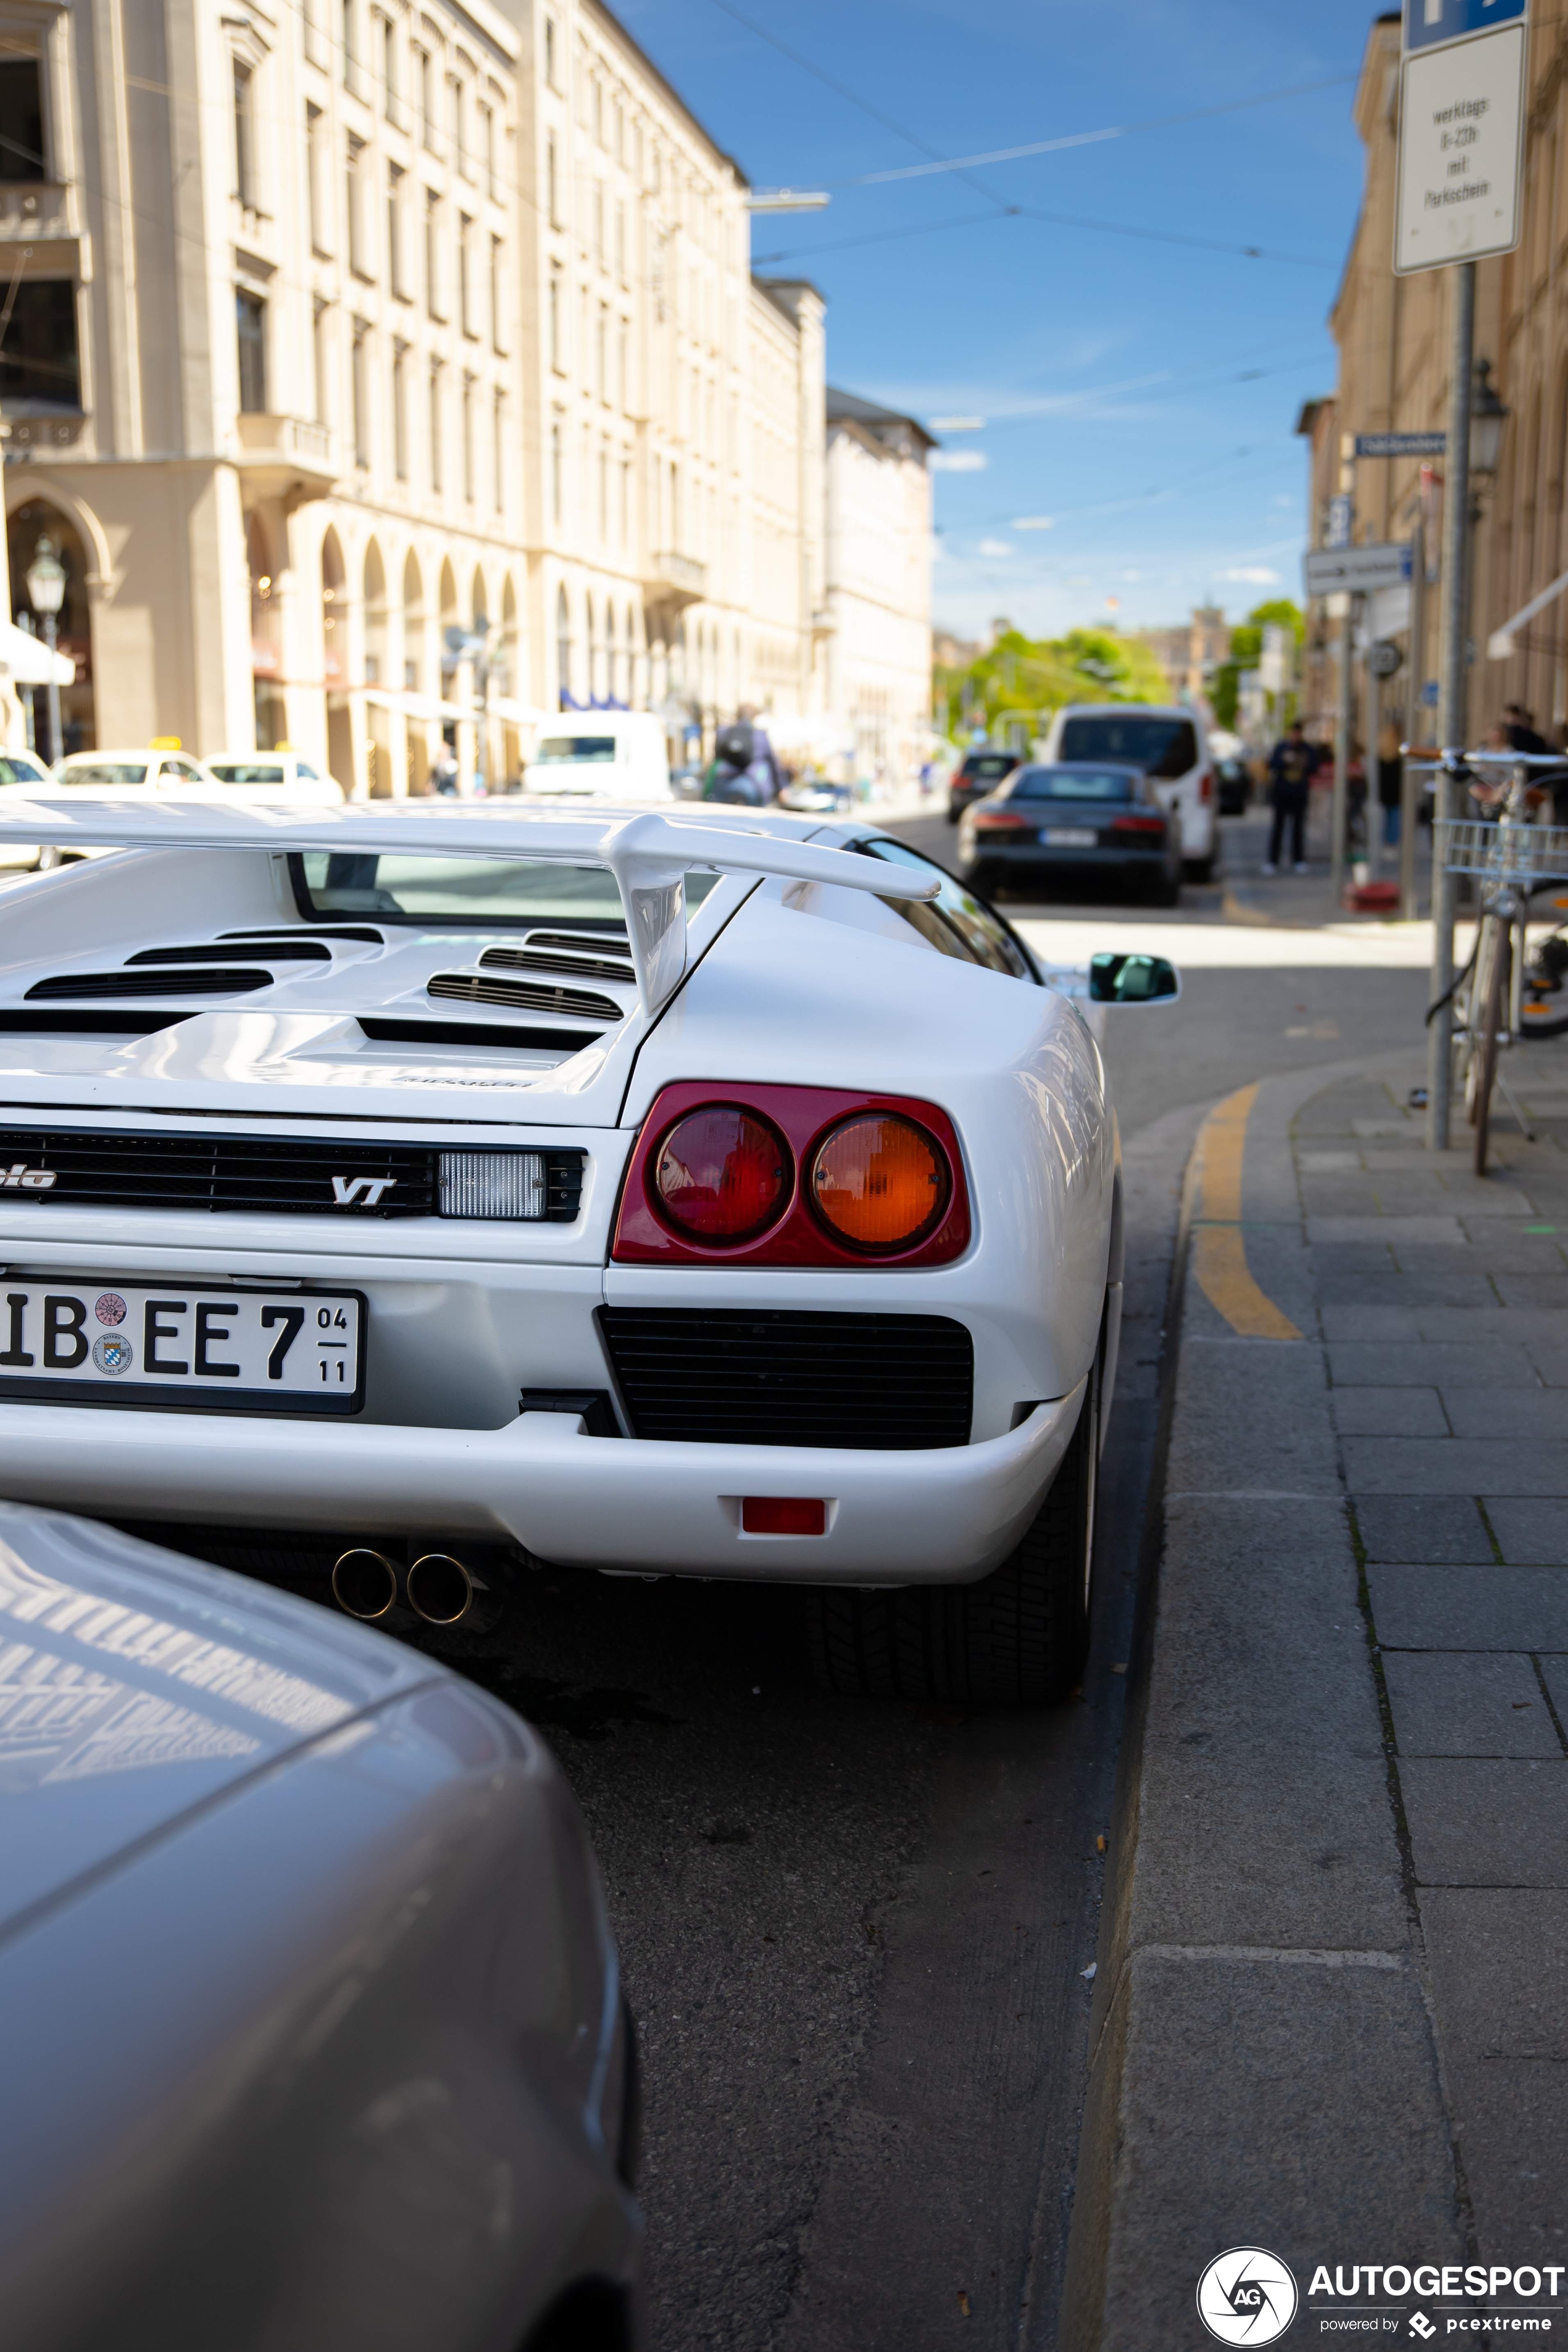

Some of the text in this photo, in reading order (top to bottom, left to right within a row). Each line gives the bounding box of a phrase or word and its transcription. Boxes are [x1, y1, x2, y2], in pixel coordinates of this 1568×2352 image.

[1432, 97, 1490, 127] werktags
[1447, 155, 1470, 177] mit
[1424, 179, 1491, 210] Parkschein
[0, 1164, 57, 1189] lo
[332, 1176, 397, 1206] VT
[317, 1307, 347, 1329] 04
[0, 1293, 304, 1380] IB EE 7
[94, 1348, 131, 1374] LANDRATSAMT ROSENHEIM
[319, 1360, 344, 1382] 11
